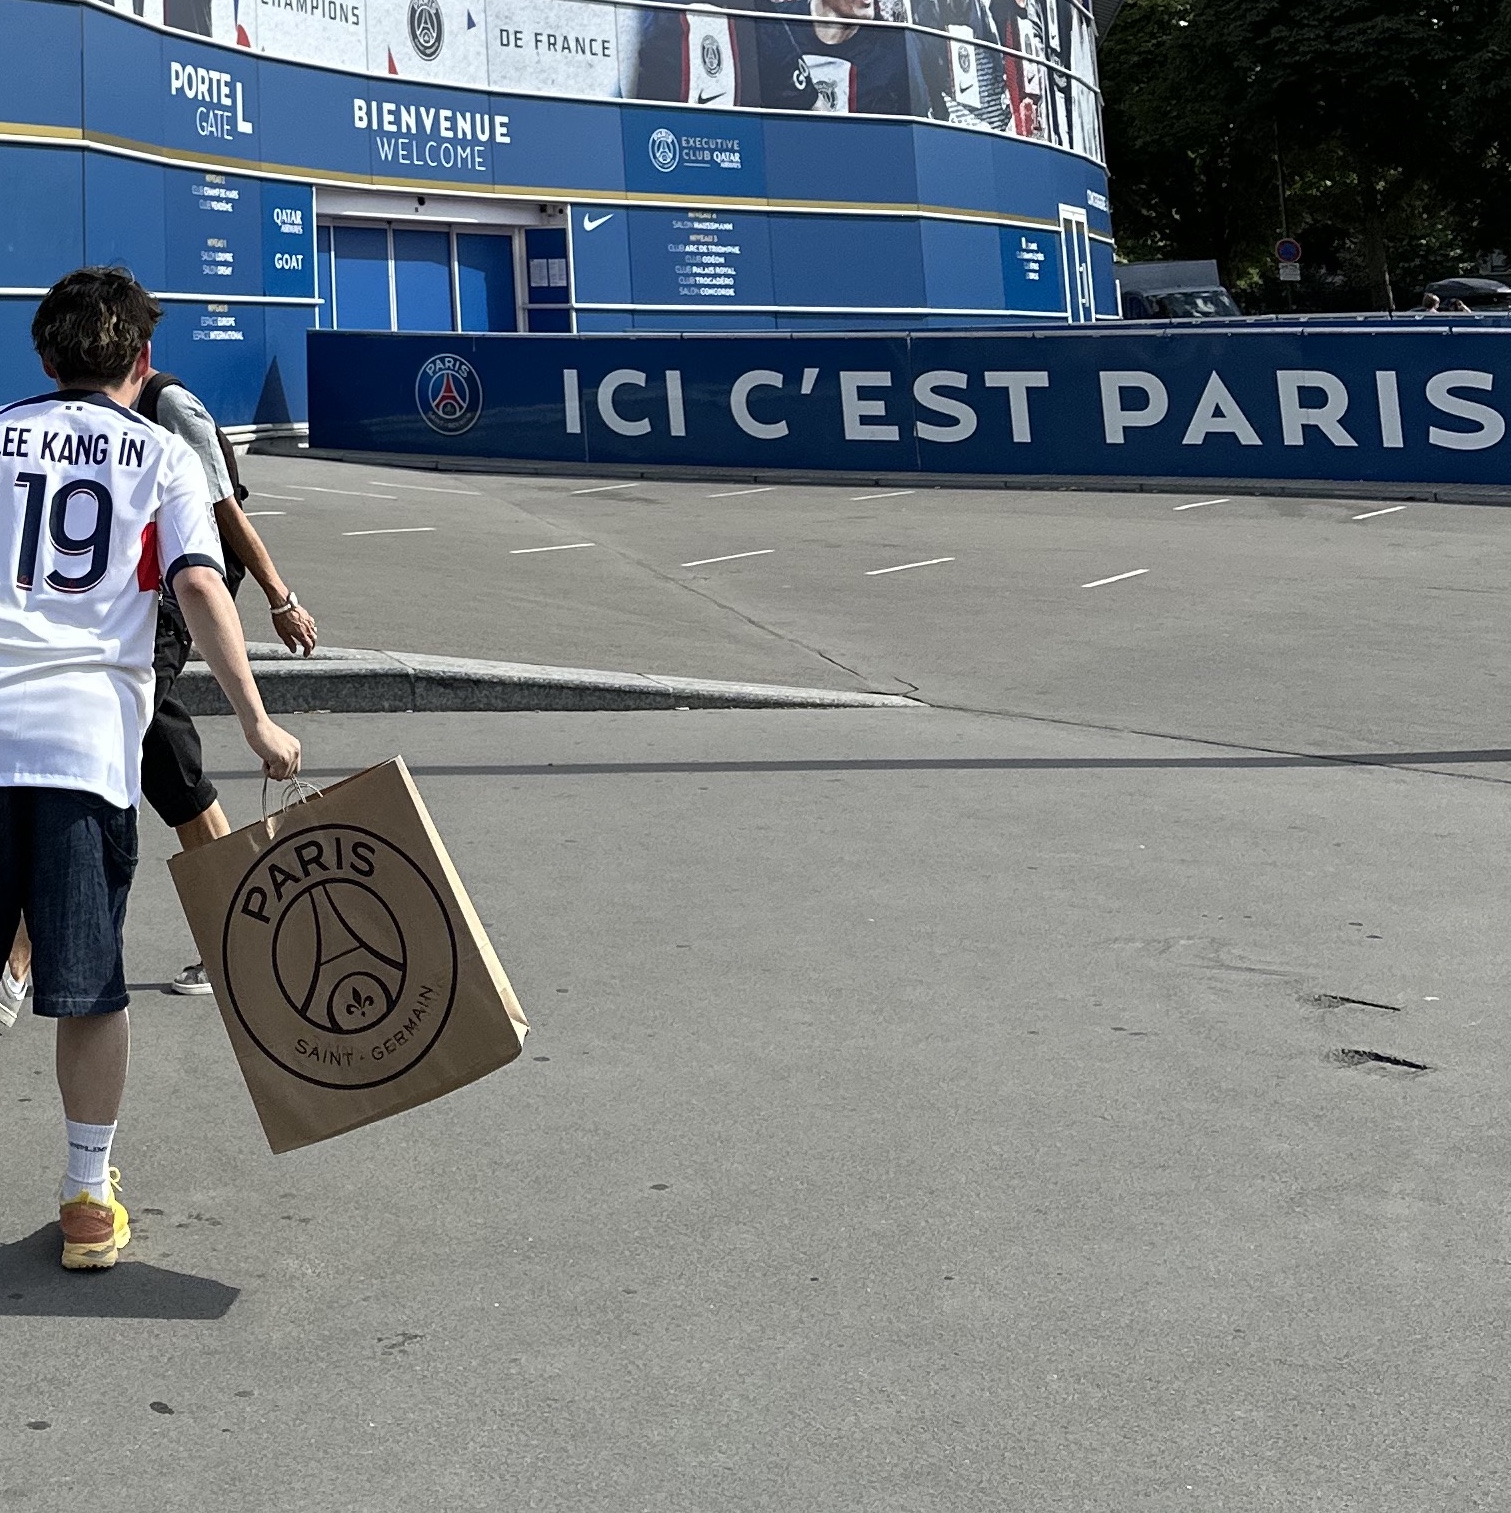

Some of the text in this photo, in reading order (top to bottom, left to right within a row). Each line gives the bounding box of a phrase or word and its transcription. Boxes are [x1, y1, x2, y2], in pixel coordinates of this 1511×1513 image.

[499, 28, 611, 58] DE FRANCE
[171, 61, 232, 106] PORTE
[196, 106, 233, 140] GATE
[236, 82, 253, 134] L
[353, 98, 511, 143] BIENVENUE
[376, 136, 487, 171] WELCOME
[681, 136, 740, 150] EXECUTIVE
[682, 149, 741, 163] CLUB QATAR
[274, 208, 303, 226] QATAR
[275, 253, 304, 270] GOAT
[668, 244, 685, 252] CLUB
[685, 255, 702, 263] CLUB
[675, 266, 736, 275] CLUB PALAIS ROYAL
[678, 277, 695, 285] CLUB
[425, 357, 470, 378] PARIS
[563, 367, 1506, 451] ICI C'EST PARIS
[40, 430, 109, 466] KANG
[14, 471, 113, 594] 19
[241, 837, 376, 925] PARIS
[294, 985, 434, 1067] SAINT GERMAIN
